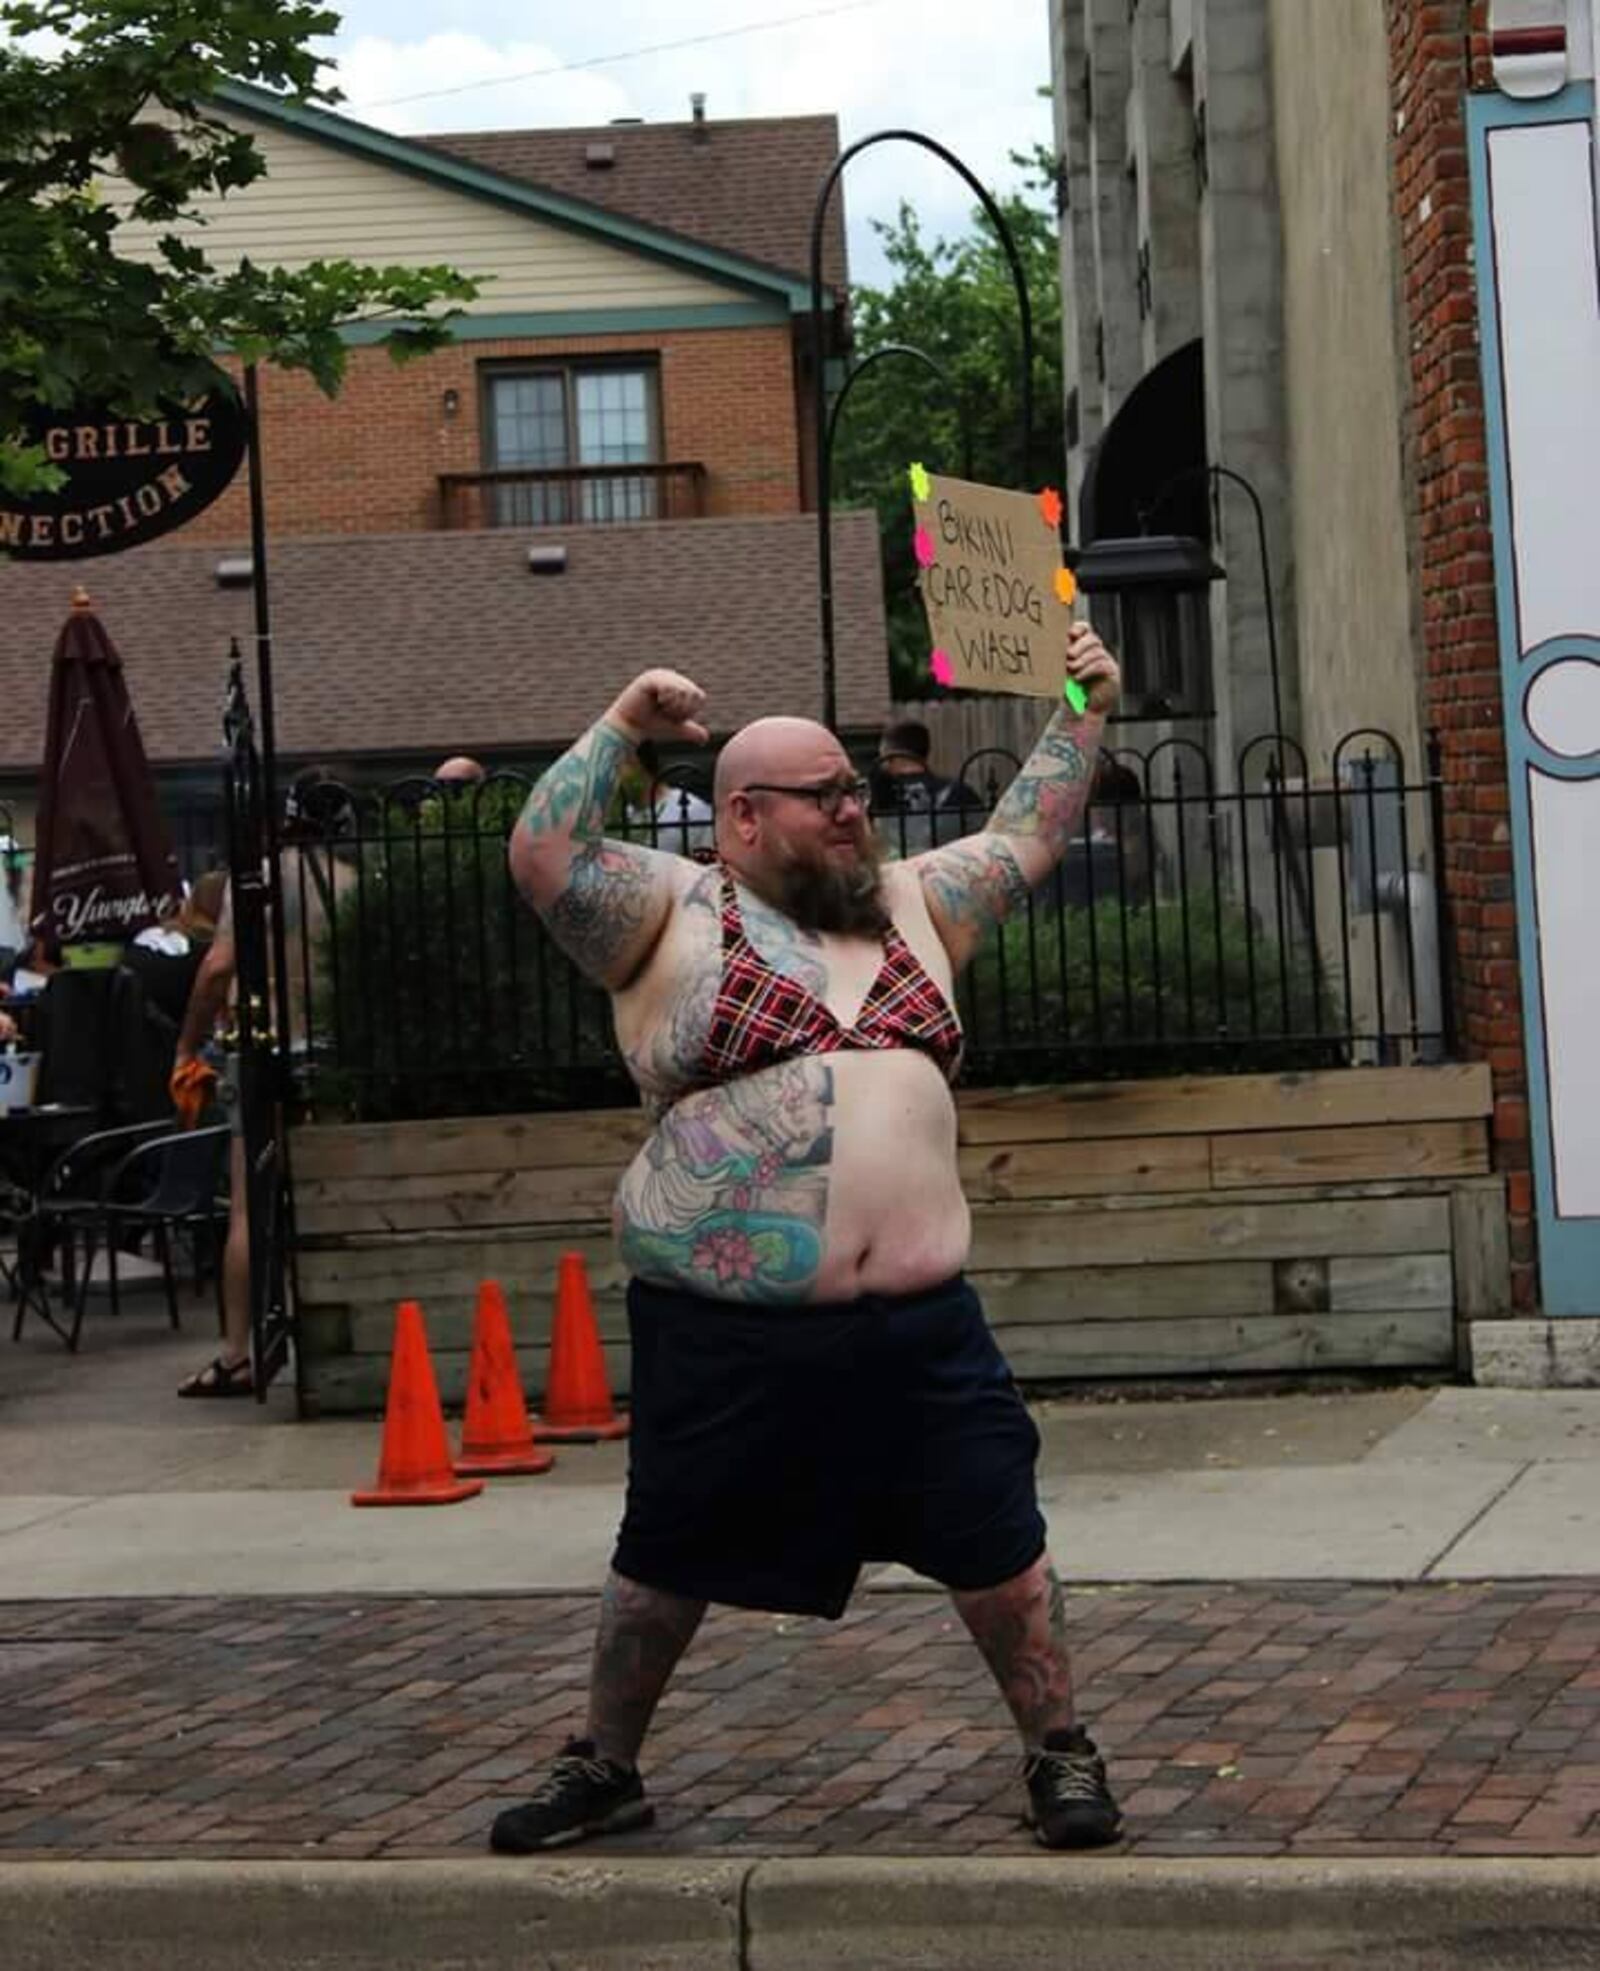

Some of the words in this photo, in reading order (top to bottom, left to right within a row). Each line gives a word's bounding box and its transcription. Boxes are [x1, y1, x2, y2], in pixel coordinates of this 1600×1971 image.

[47, 418, 211, 459] GRILLE
[938, 499, 1015, 566] BIKINI
[928, 564, 979, 612] CAR
[995, 573, 1043, 626] DOG
[956, 628, 1032, 674] WASH
